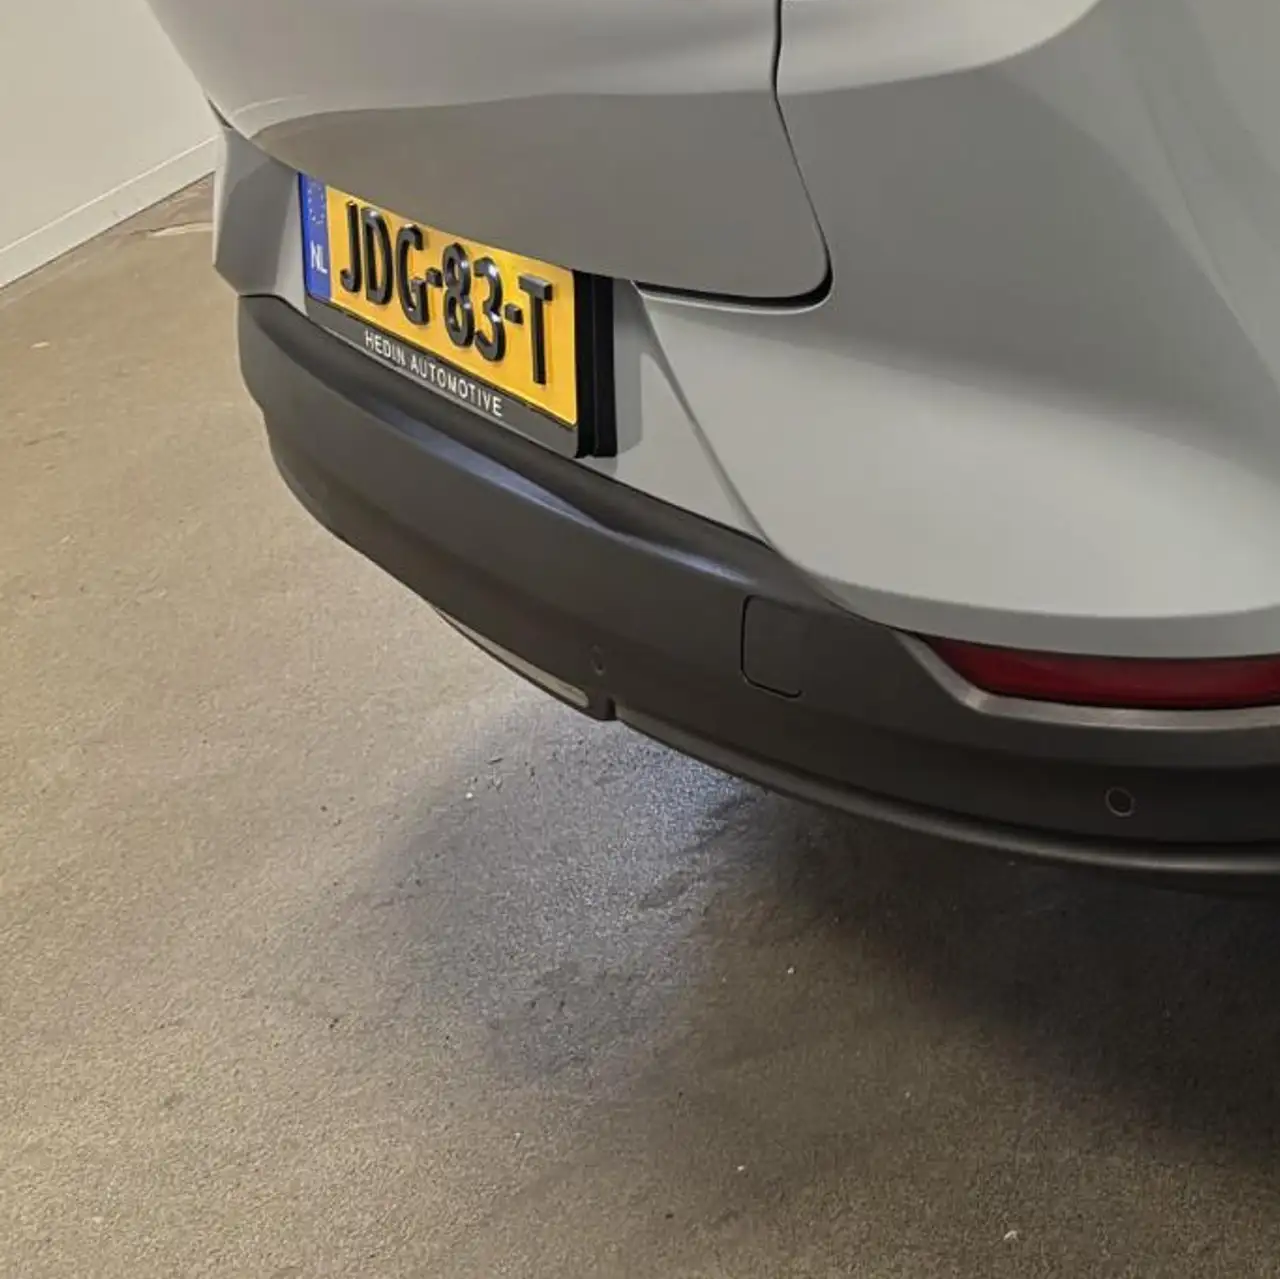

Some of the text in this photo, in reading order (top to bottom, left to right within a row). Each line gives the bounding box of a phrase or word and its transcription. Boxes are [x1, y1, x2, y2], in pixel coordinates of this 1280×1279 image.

[309, 239, 328, 276] NL
[339, 200, 553, 385] JDG-83-T
[363, 329, 503, 418] HEDIN AUTOMOTIVE
